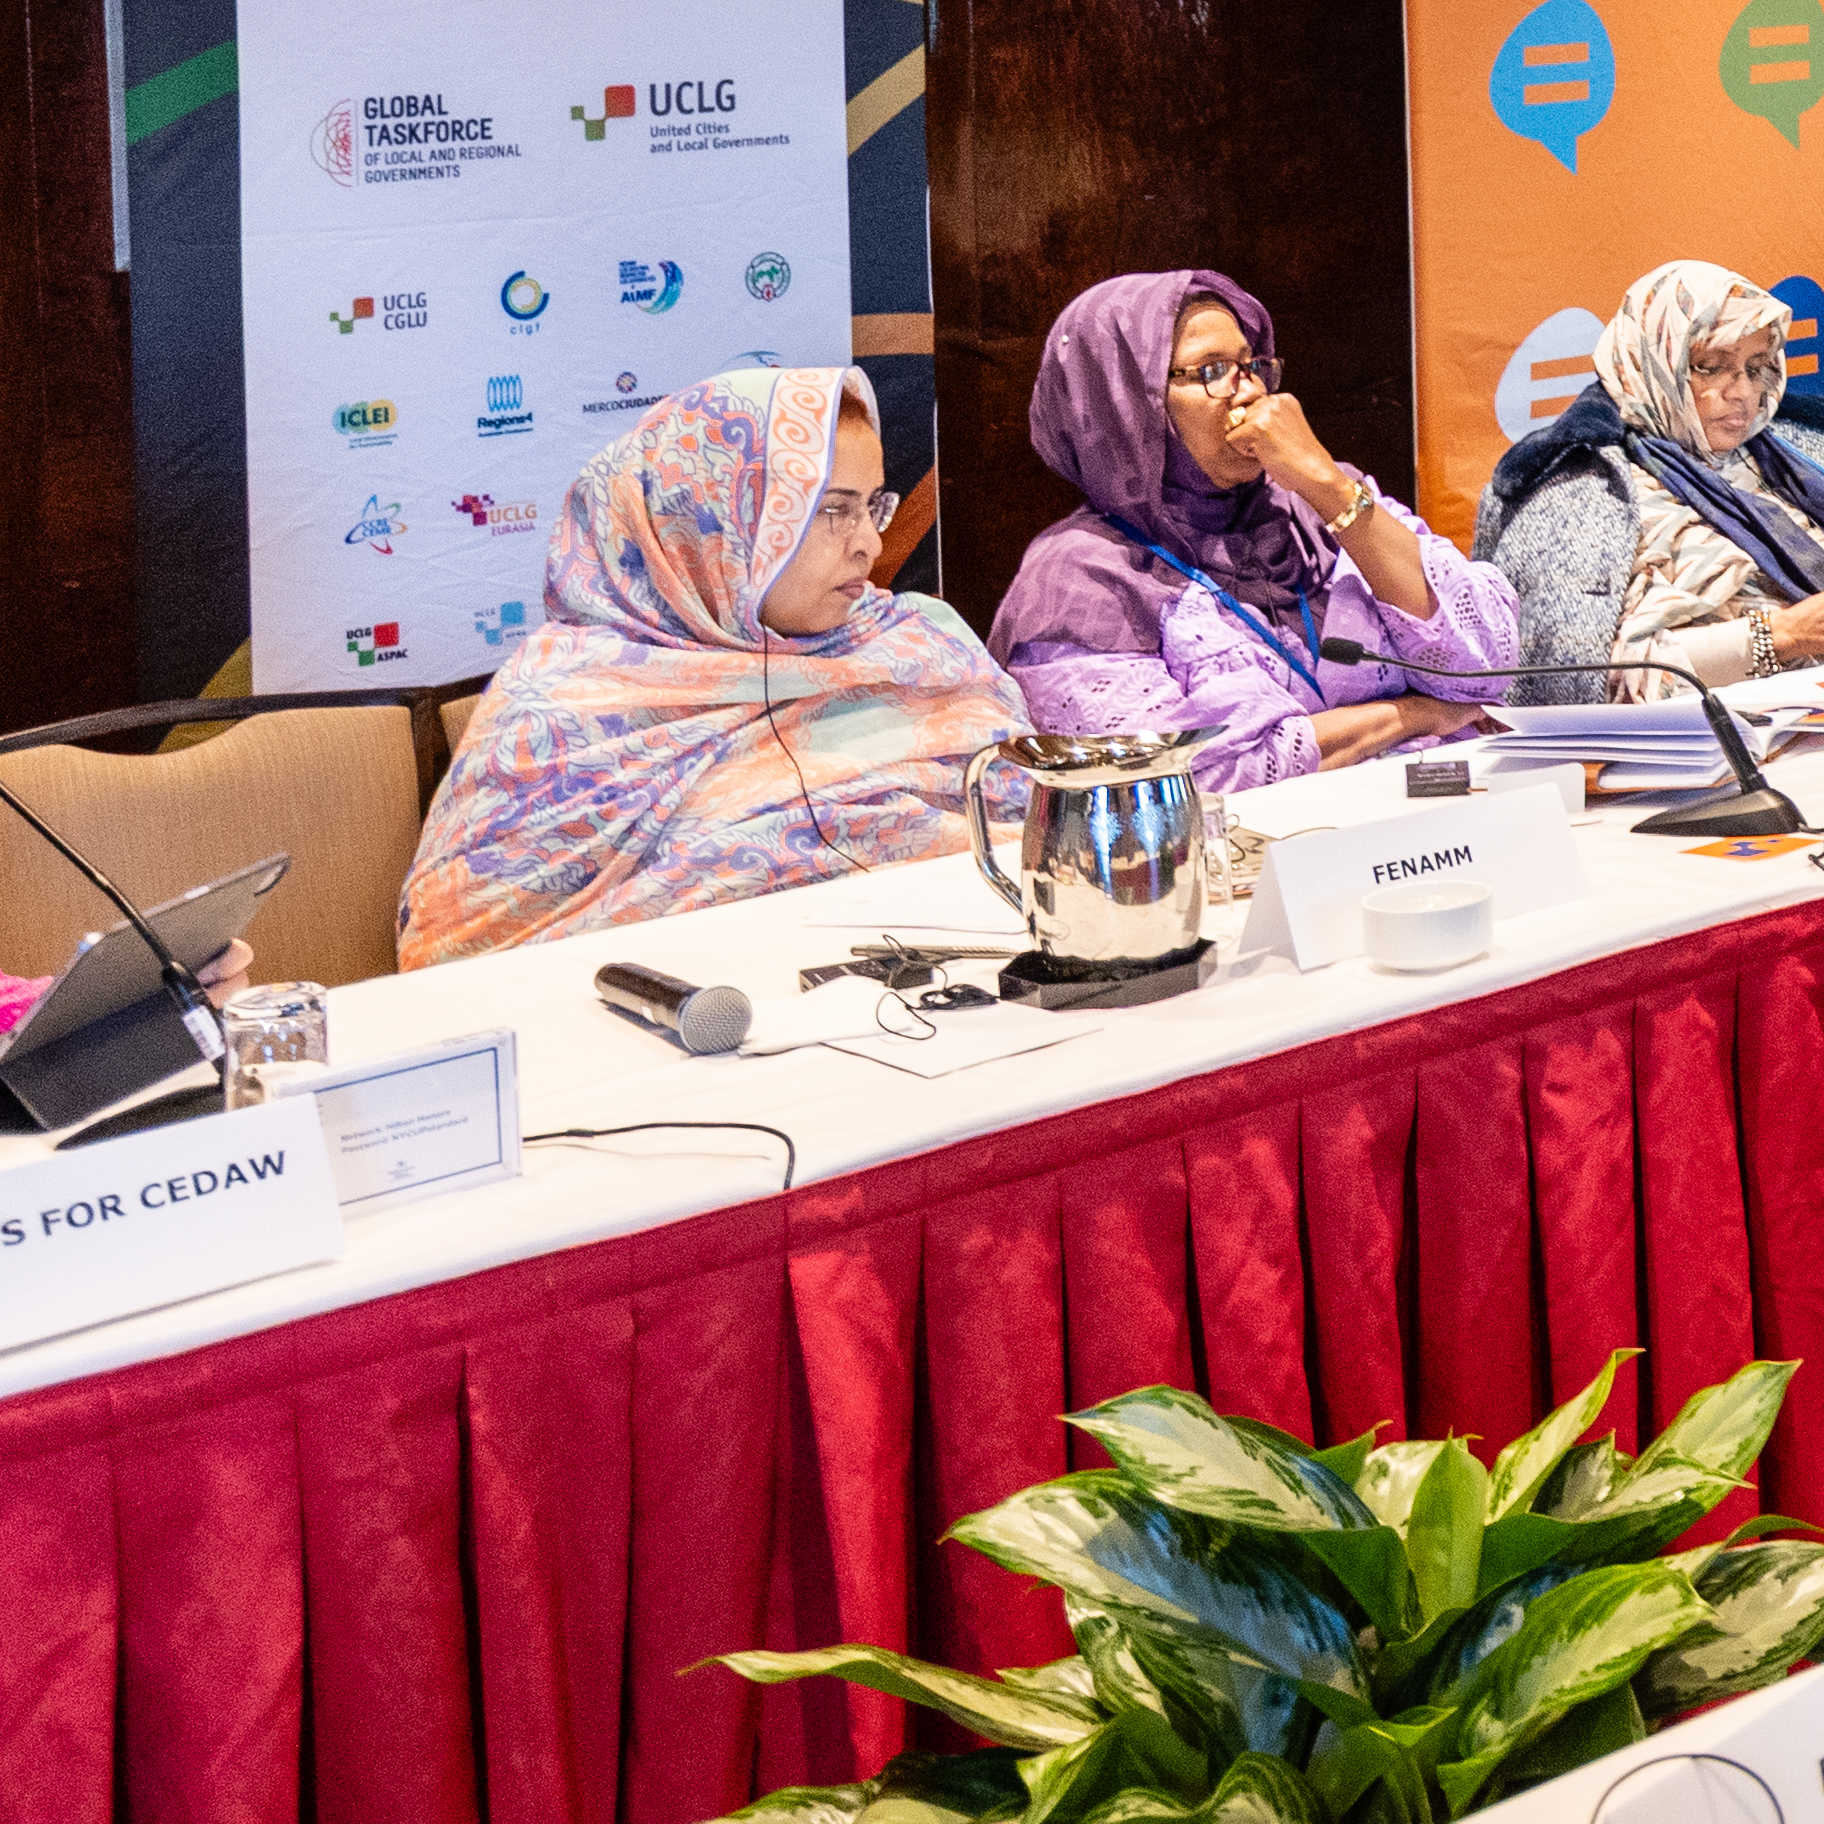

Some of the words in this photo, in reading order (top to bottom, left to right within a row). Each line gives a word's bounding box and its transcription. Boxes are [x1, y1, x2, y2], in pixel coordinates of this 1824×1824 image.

[364, 94, 449, 120] GLOBAL
[649, 80, 736, 116] UCLG
[365, 117, 493, 146] TASKFORCE
[650, 124, 692, 139] United
[695, 122, 730, 136] Cities
[650, 140, 674, 154] and
[677, 137, 708, 152] Local
[712, 133, 791, 150] Governments
[365, 151, 381, 167] OF
[384, 149, 425, 166] LOCAL
[428, 147, 456, 162] AND
[460, 143, 522, 160] REGIONAL
[365, 164, 461, 184] GOVERNMENTS
[383, 292, 428, 312] UCLG
[383, 310, 428, 331] CGLU
[340, 407, 390, 428] ICLEI
[490, 503, 538, 523] UCLG
[1372, 845, 1473, 885] FENAMM
[40, 1193, 126, 1238] FOR
[139, 1149, 287, 1210] CEDAW
